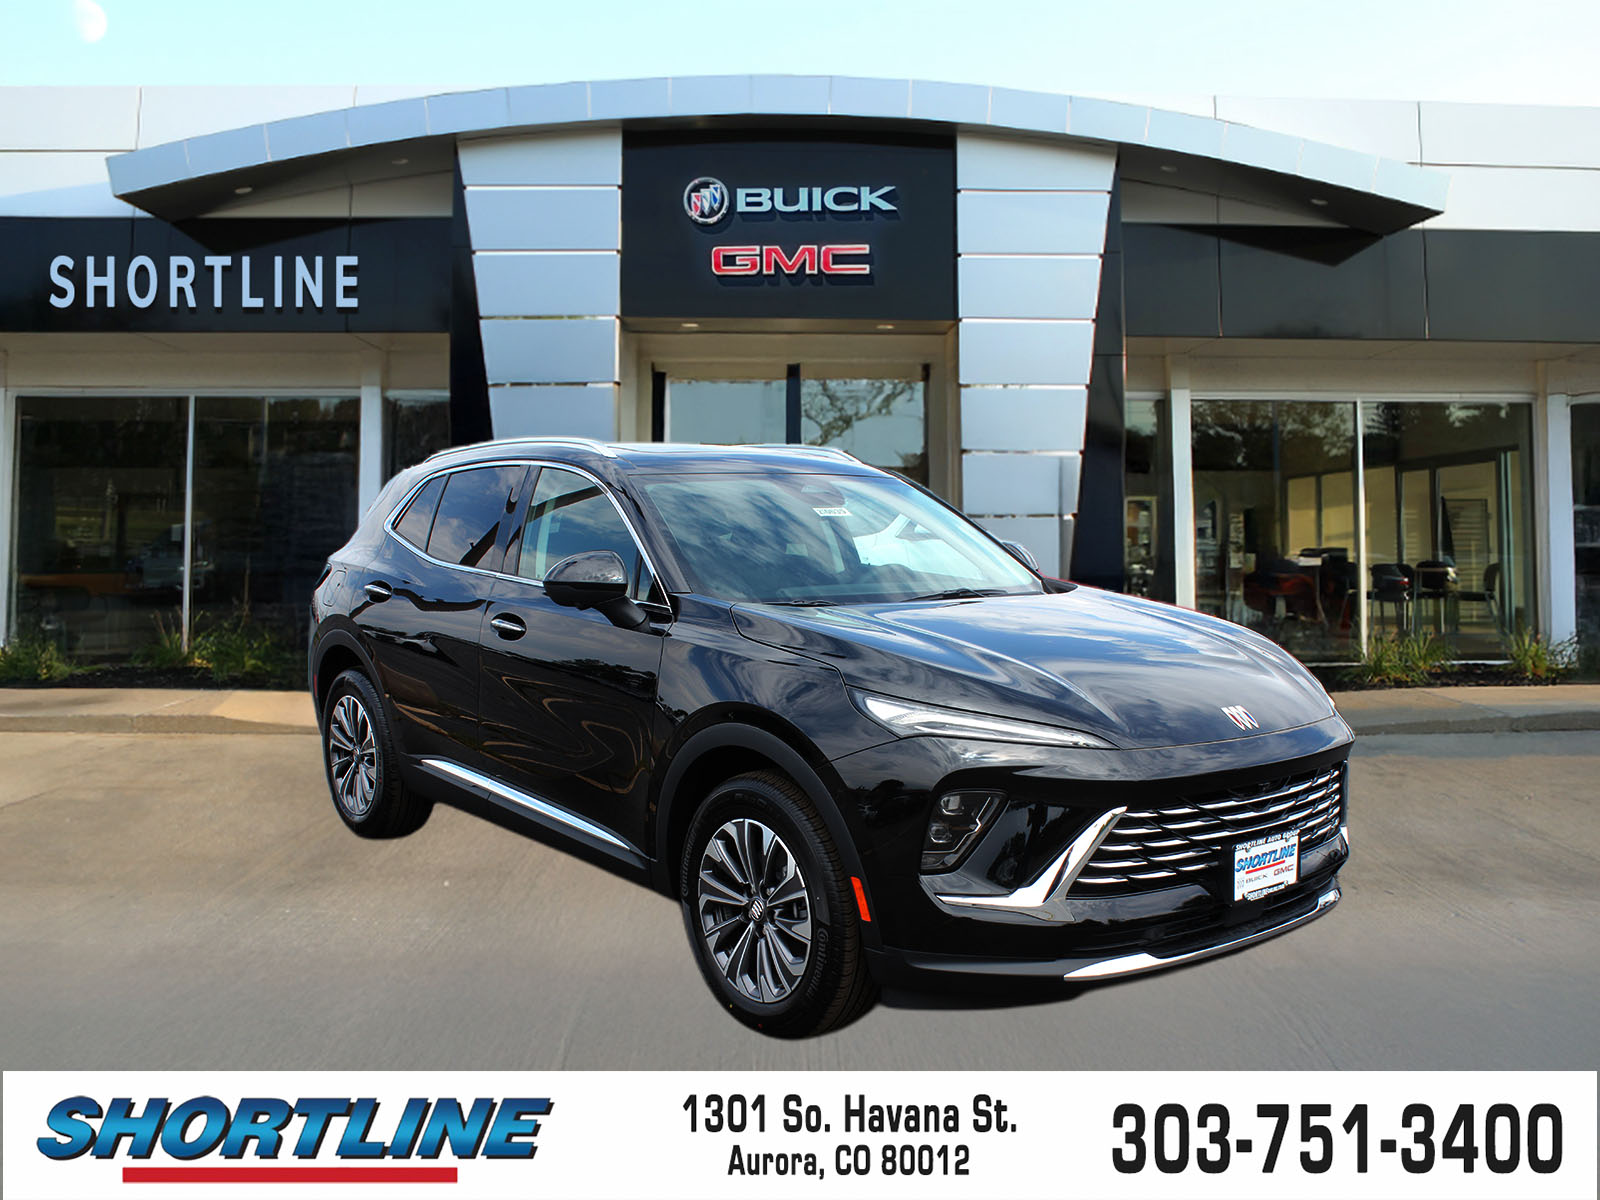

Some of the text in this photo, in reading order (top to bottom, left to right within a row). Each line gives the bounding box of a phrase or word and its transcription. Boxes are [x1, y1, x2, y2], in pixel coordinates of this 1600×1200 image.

[736, 186, 898, 212] BUICK
[712, 244, 870, 275] GMC
[49, 255, 359, 308] SHORTLINE
[1235, 843, 1297, 872] SHORTLINE
[1273, 864, 1294, 876] GMC
